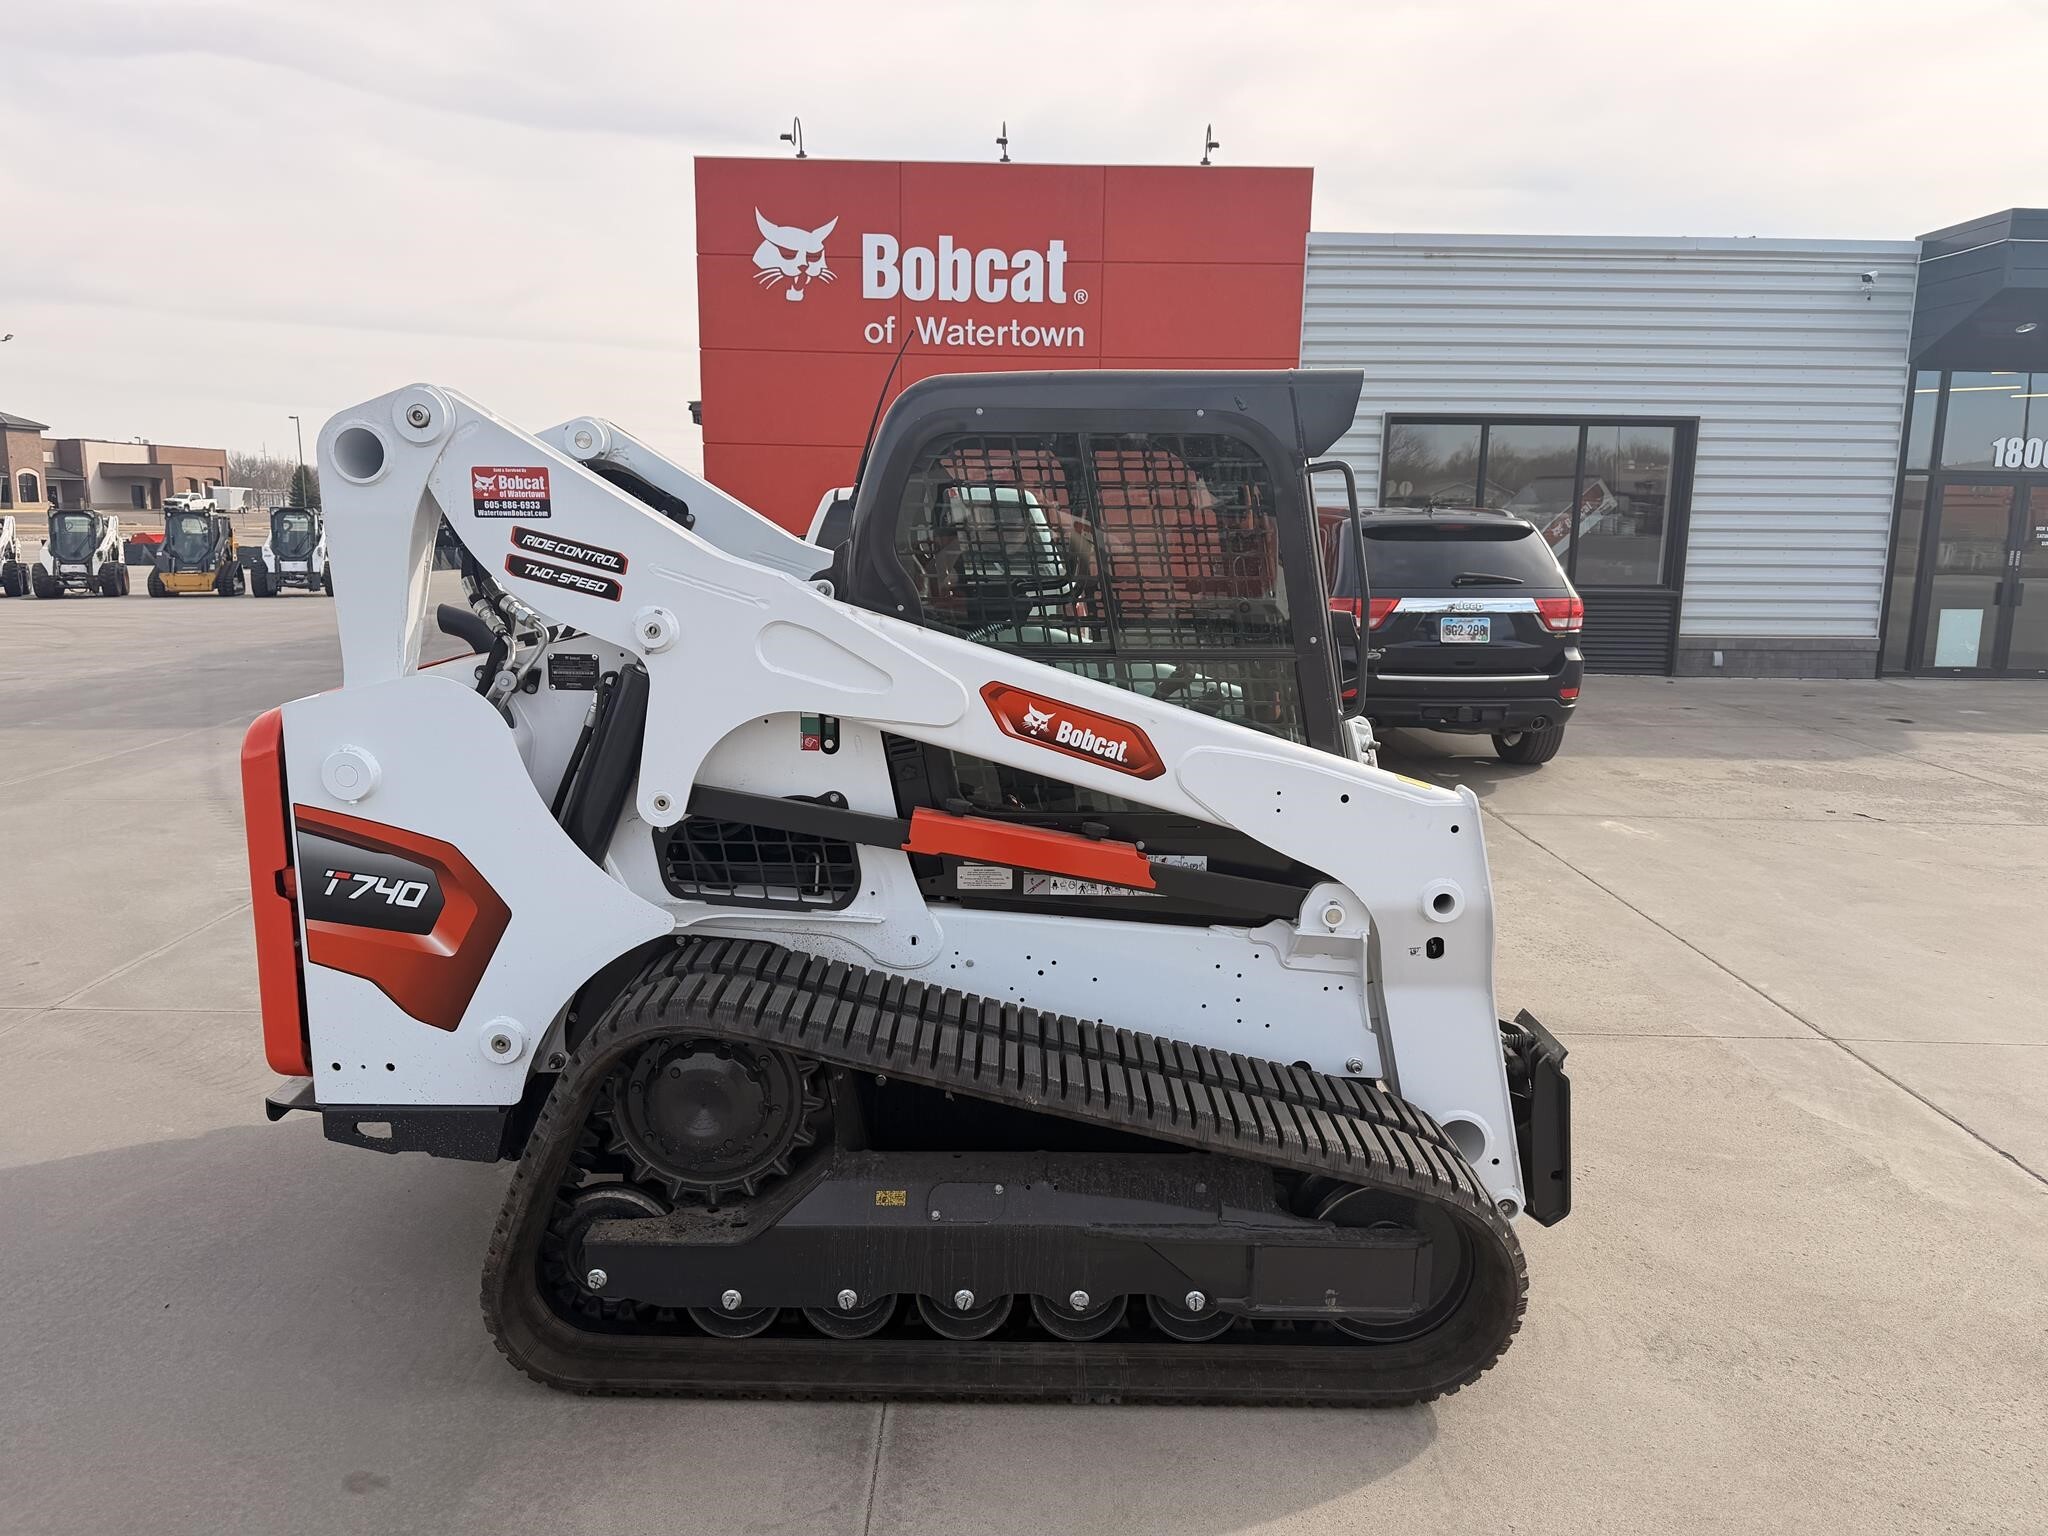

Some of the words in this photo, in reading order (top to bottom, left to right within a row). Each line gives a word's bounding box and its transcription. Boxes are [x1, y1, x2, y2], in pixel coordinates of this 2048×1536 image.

[864, 315, 896, 344] of
[915, 316, 1085, 347] Watertown
[498, 475, 545, 490] Bobcat
[500, 490, 507, 498] of
[508, 490, 546, 498] Watertown
[478, 509, 549, 518] WatertownBobcat.com
[484, 501, 541, 510] 605-886-6933
[521, 534, 558, 551] RIDE
[554, 544, 620, 568] CONTROL
[524, 563, 608, 593] TWO-SPEED
[1455, 600, 1484, 612] Jeep
[1055, 720, 1127, 763] Bobcat
[324, 869, 429, 908] T740
